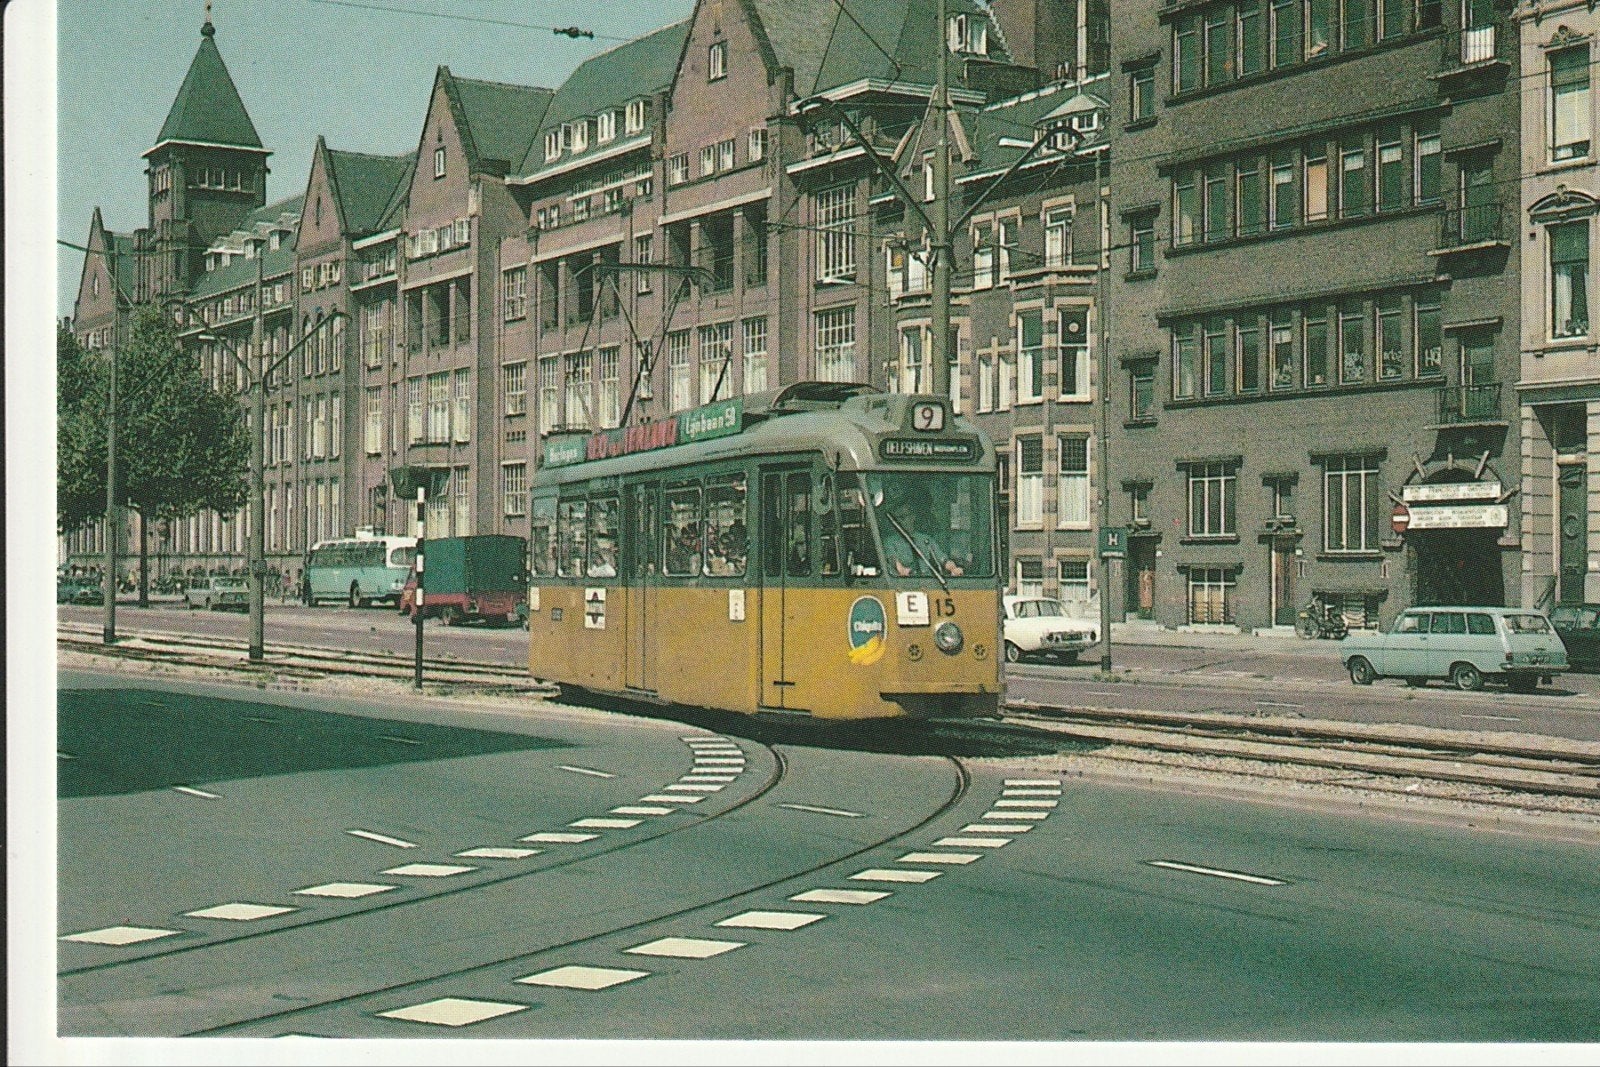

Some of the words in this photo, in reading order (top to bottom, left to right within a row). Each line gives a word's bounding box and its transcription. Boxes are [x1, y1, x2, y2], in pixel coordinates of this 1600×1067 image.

[921, 406, 934, 429] 9
[1108, 533, 1118, 546] H
[906, 594, 919, 613] E
[935, 598, 955, 617] 15
